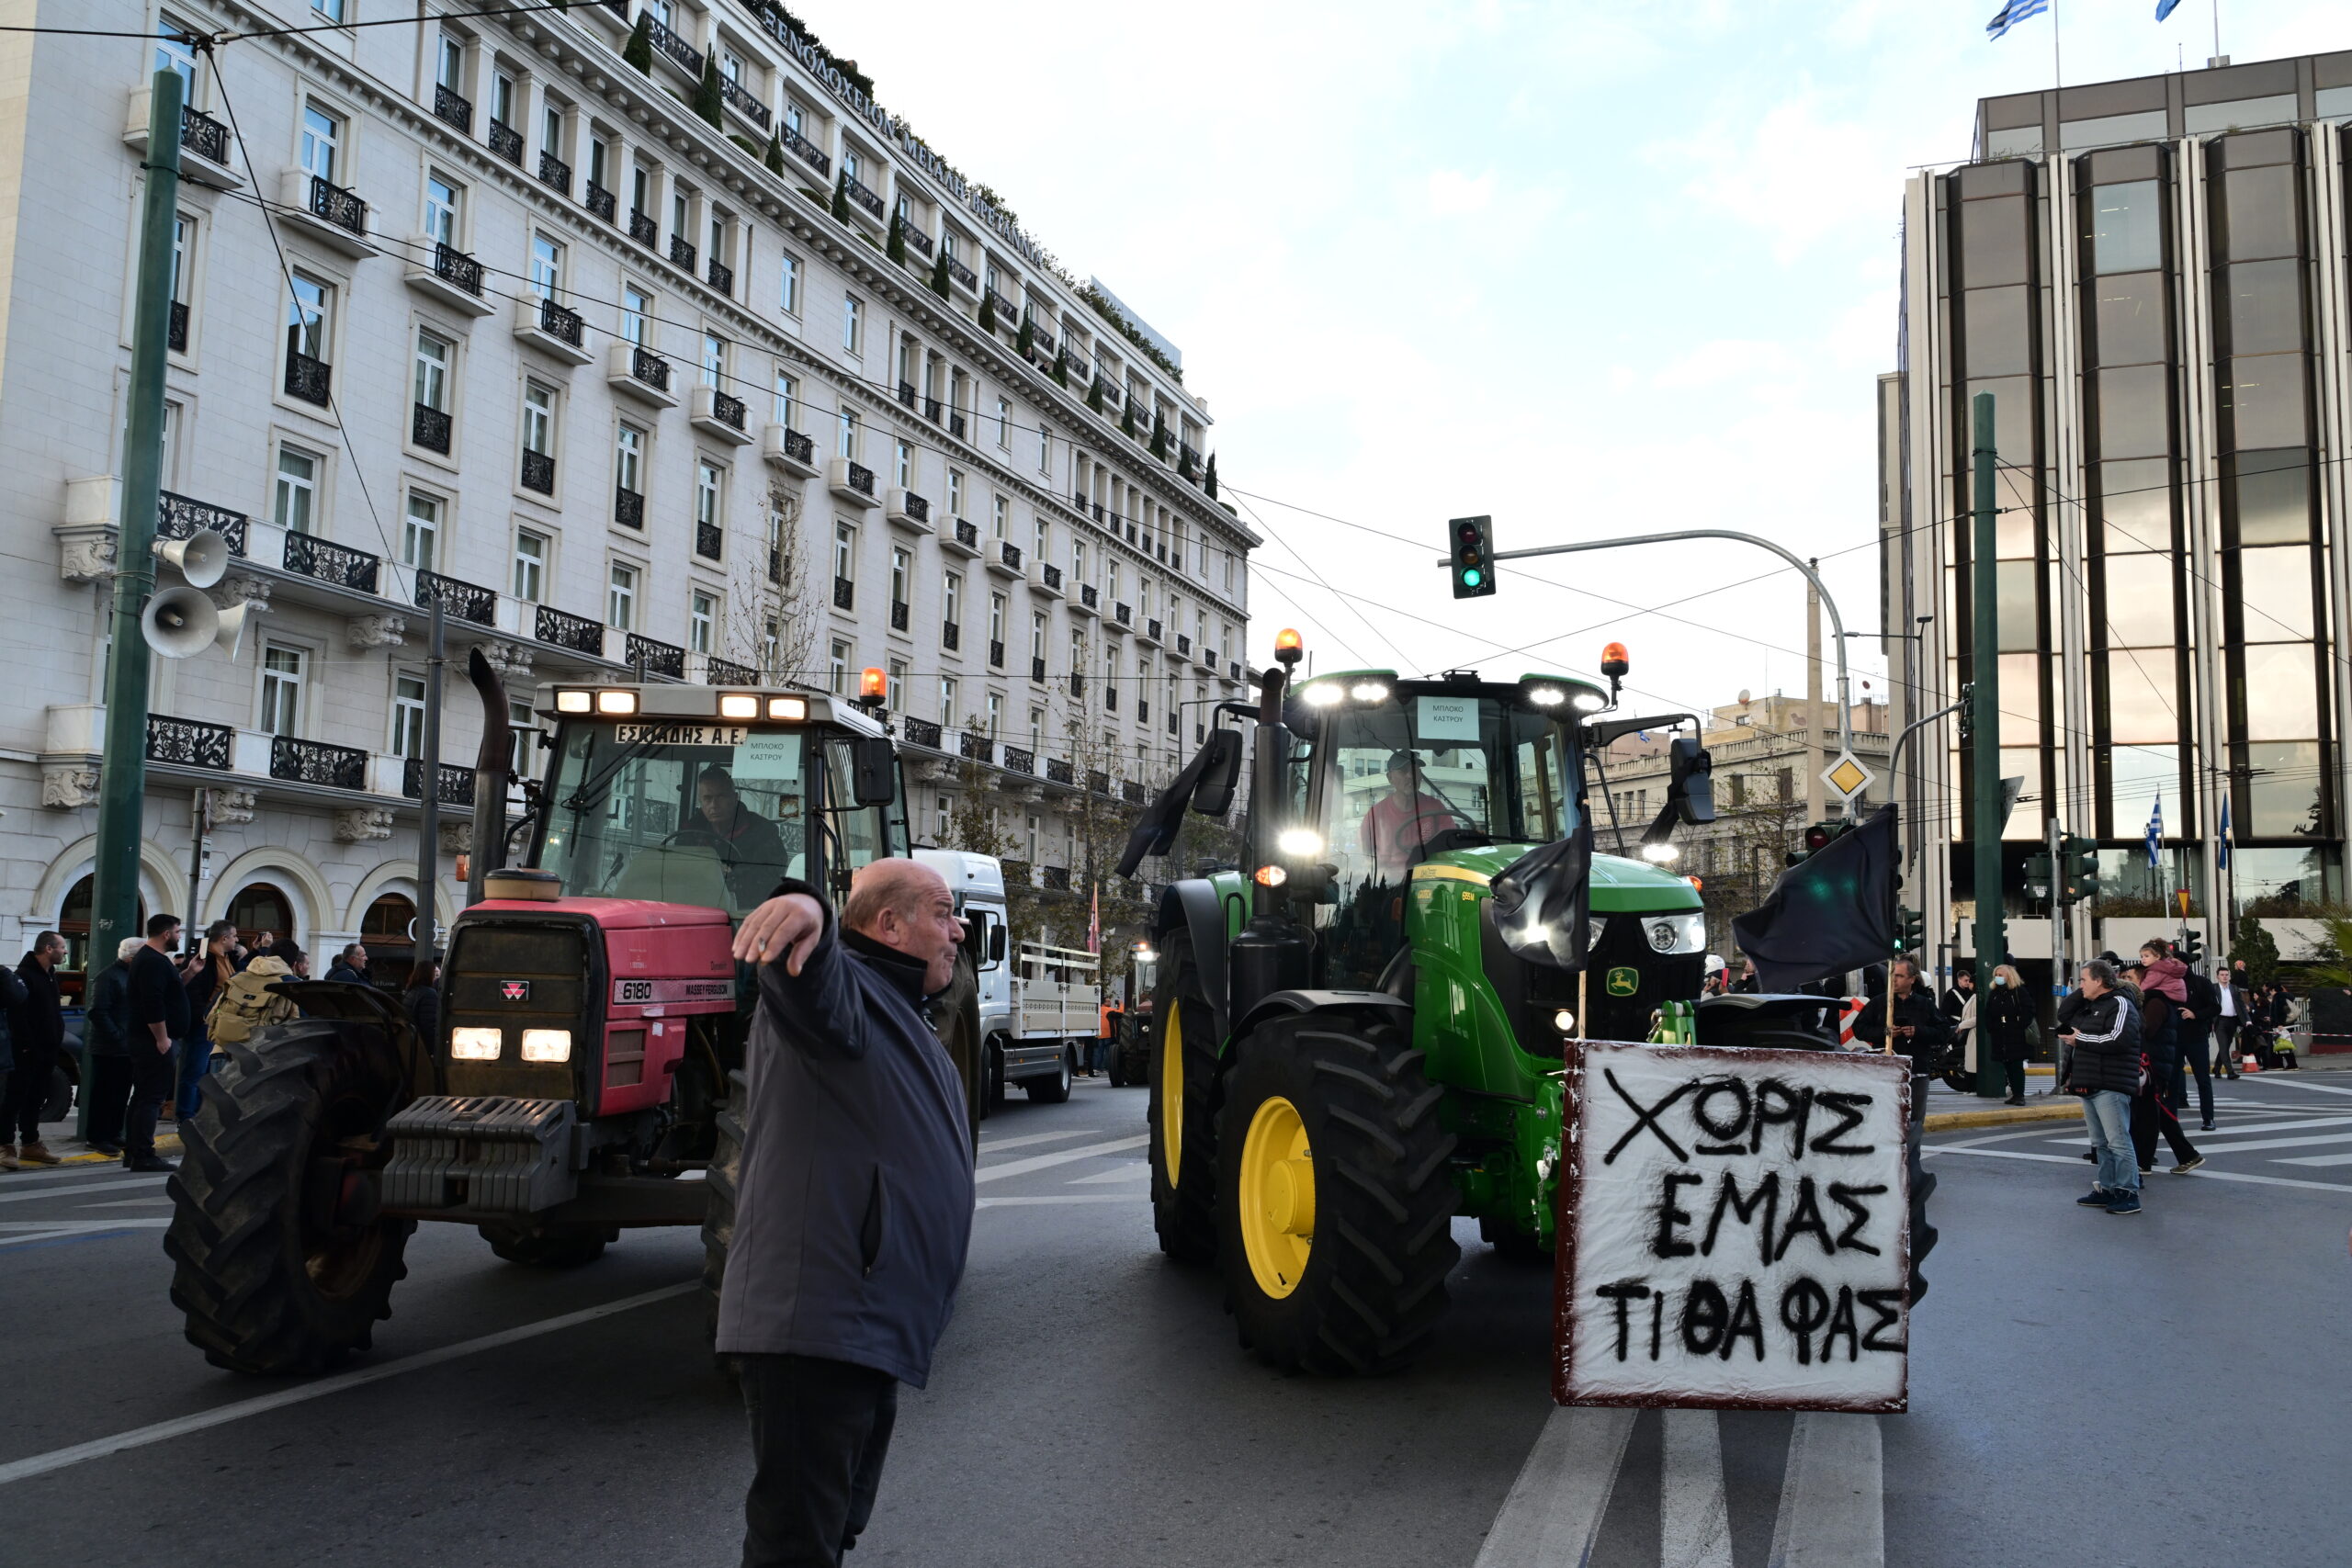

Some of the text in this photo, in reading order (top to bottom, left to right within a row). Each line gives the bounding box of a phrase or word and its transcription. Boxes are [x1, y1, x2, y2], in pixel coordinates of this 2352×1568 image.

[761, 6, 1044, 270] ΞΕΝΟΔΟΧΕΙΟΝ ΜΕΓΑΛΗ ΒΡΕΤΑΝΝΙΑ
[1432, 705, 1464, 713] ΜΠΛΟΚΟ
[750, 742, 785, 750] ΜΠΛΟΚΟ
[750, 753, 783, 761] ΚΑΣΤΡΟΥ
[623, 982, 728, 999] 6180 MASSEY FERGUSON
[1604, 1067, 1875, 1165] ΧΩΡΙΣ
[1653, 1171, 1888, 1267] ΕΜΑΣ
[1595, 1277, 1908, 1365] ΤΙ ΘΑ ΦΑΣ
